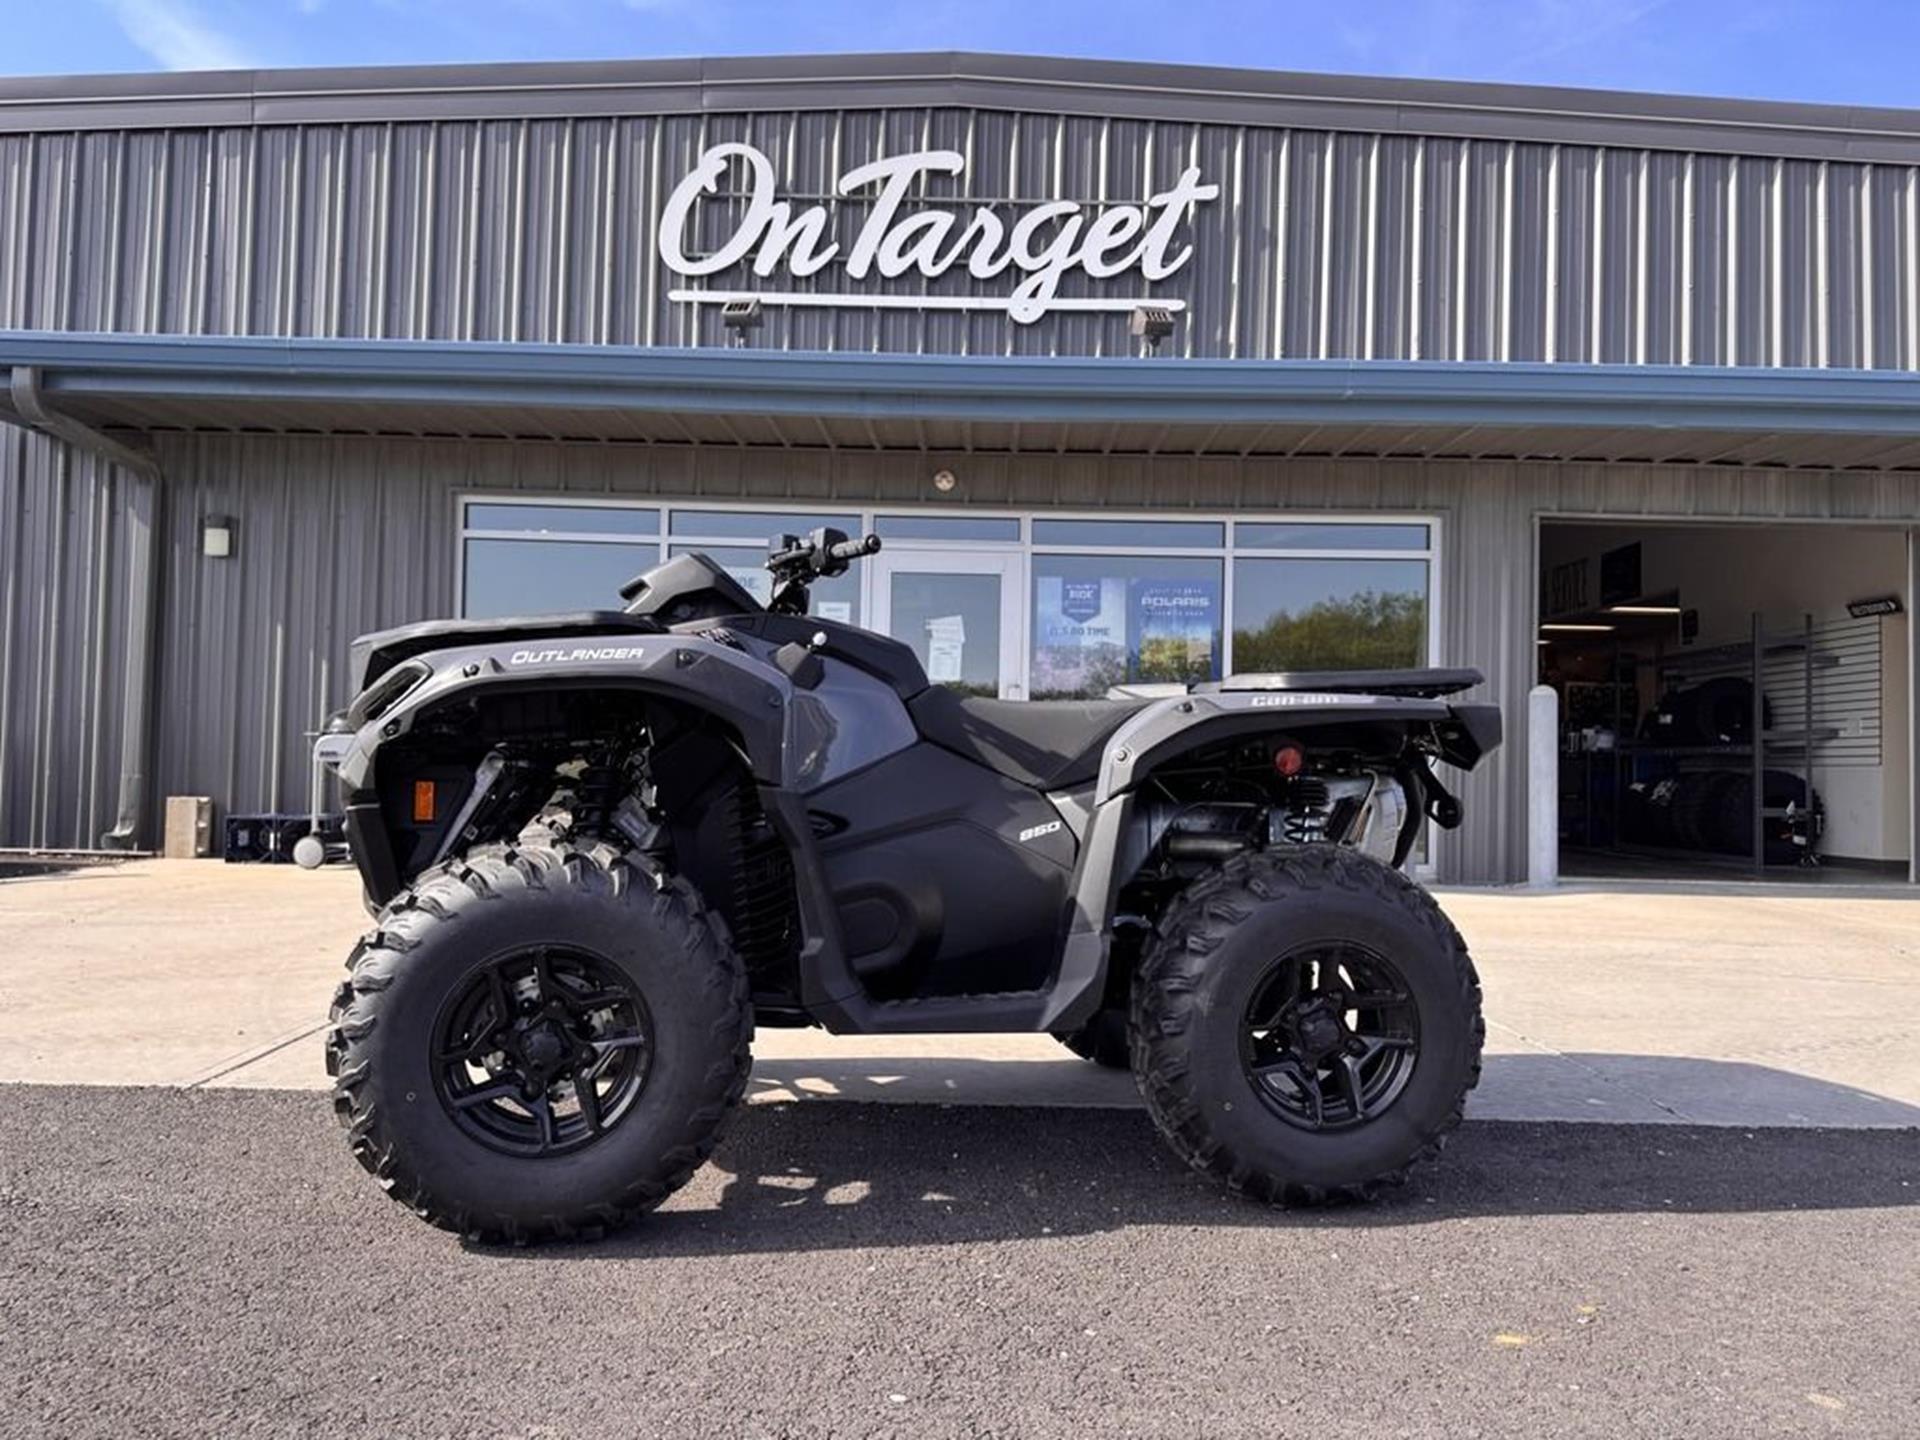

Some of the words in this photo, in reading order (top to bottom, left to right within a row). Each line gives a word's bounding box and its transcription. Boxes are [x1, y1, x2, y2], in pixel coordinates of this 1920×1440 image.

[1141, 597, 1210, 607] POLARIS
[511, 648, 644, 664] OUTLANDER
[1020, 821, 1060, 841] 850
